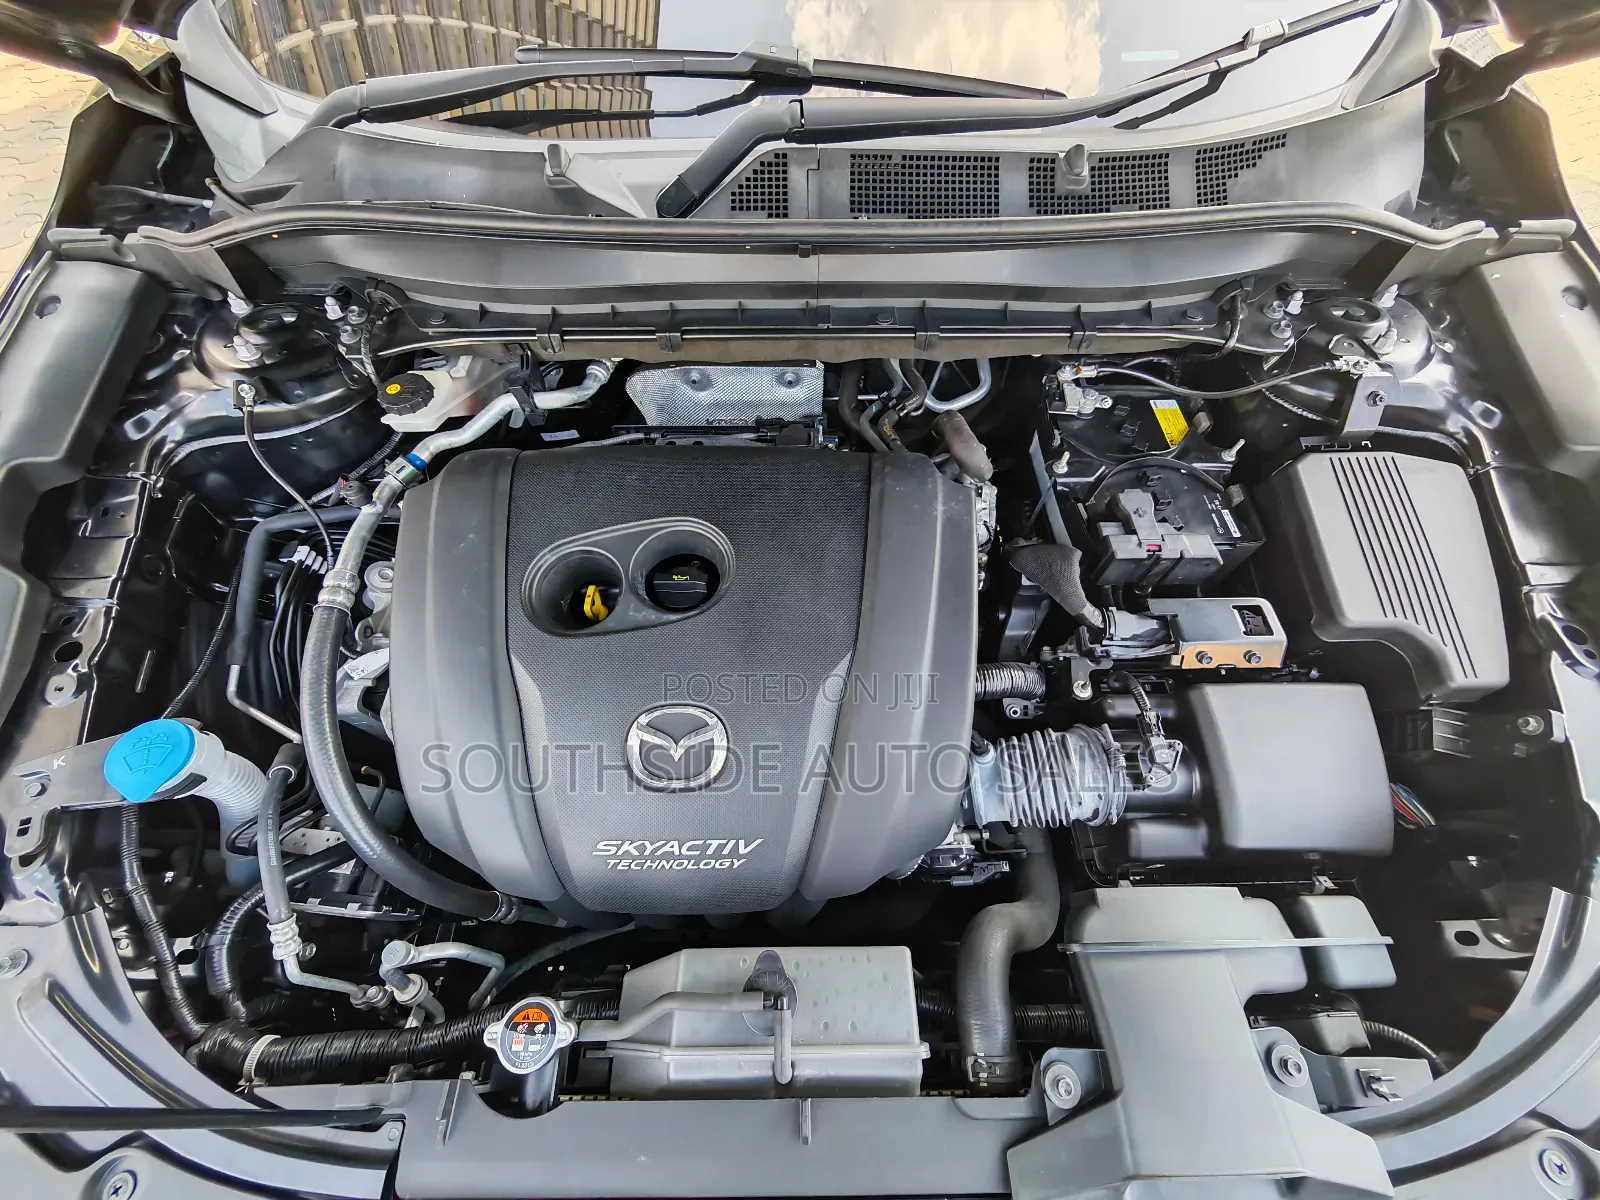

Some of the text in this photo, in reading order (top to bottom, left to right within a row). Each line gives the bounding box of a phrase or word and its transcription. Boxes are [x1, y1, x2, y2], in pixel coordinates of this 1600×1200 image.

[53, 755, 66, 770] K
[592, 838, 765, 856] SKYACTIV
[606, 858, 748, 870] TECHNOLOGY
